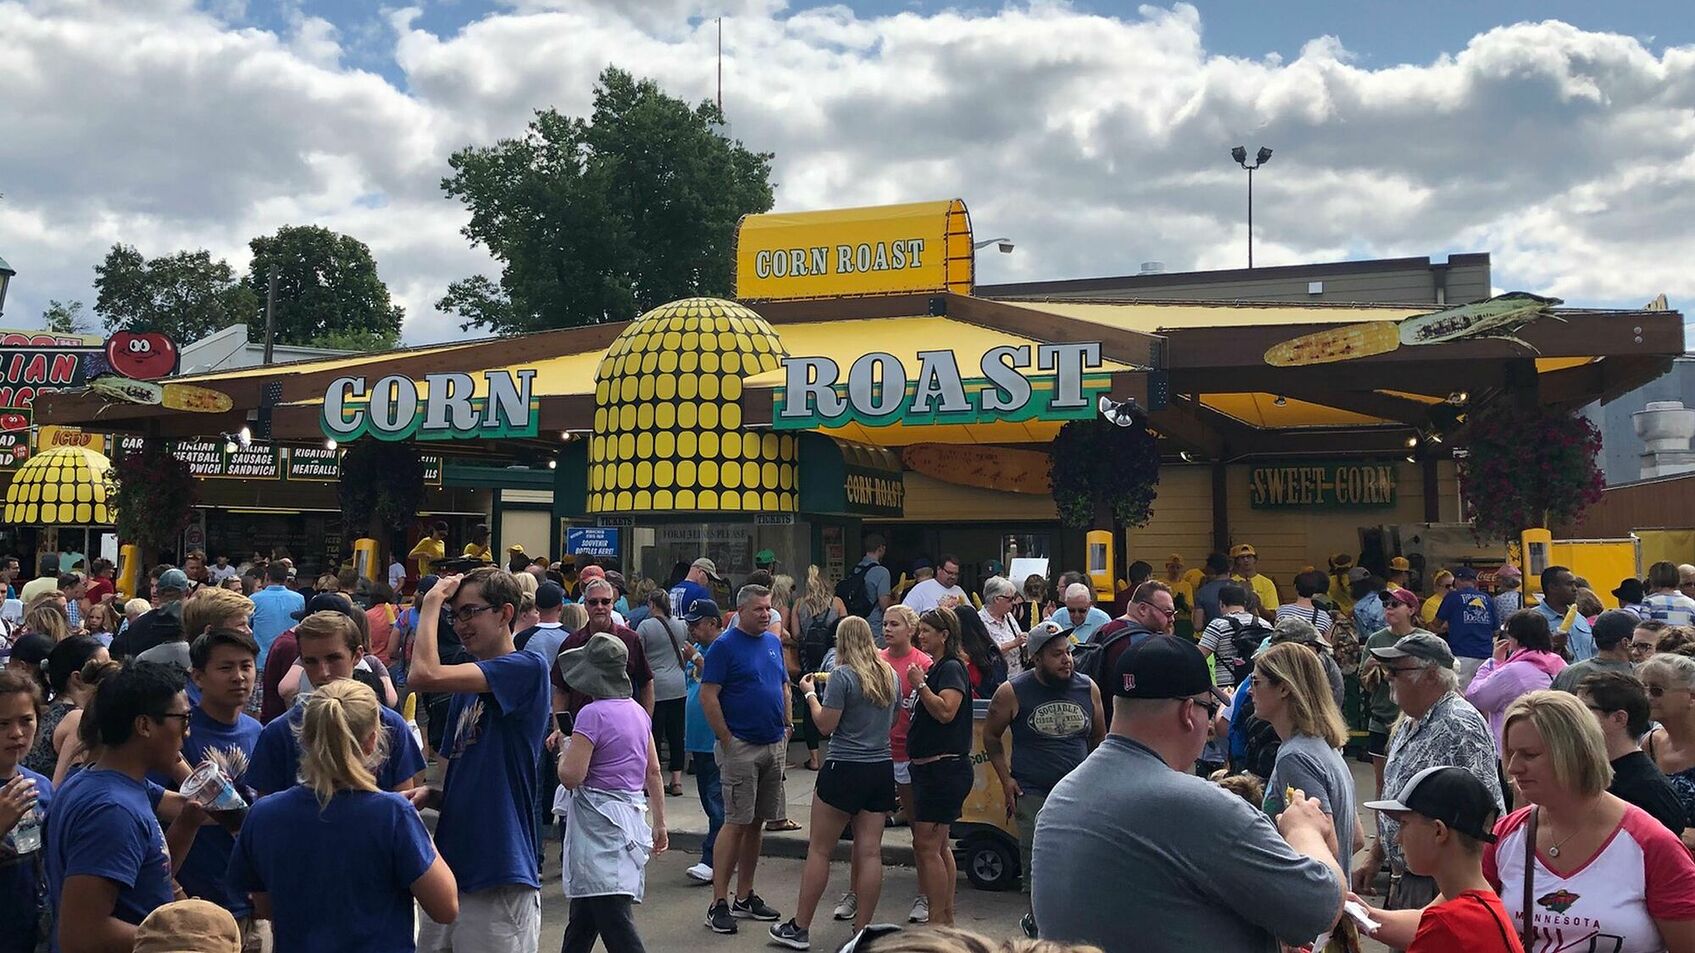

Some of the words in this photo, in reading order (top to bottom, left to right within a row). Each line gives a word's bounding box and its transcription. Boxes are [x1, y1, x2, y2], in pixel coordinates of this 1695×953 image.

[755, 246, 829, 279] CORN
[835, 238, 925, 274] ROAST
[323, 369, 537, 433] CORN
[780, 342, 1102, 418] ROAST
[51, 430, 92, 447] ICED
[231, 453, 273, 465] SAUSAGE
[190, 463, 221, 474] DWICH
[227, 465, 276, 475] SANDWICH
[292, 464, 337, 475] MEATBALLS
[846, 474, 873, 505] CORN
[875, 478, 902, 508] ROAST
[1253, 467, 1325, 504] SWEET
[1335, 466, 1392, 504] CORN
[601, 516, 633, 527] TICKETS
[757, 513, 791, 525] TICKETS
[1038, 704, 1078, 717] SOCIABLE
[1515, 911, 1601, 929] MNNESOTA
